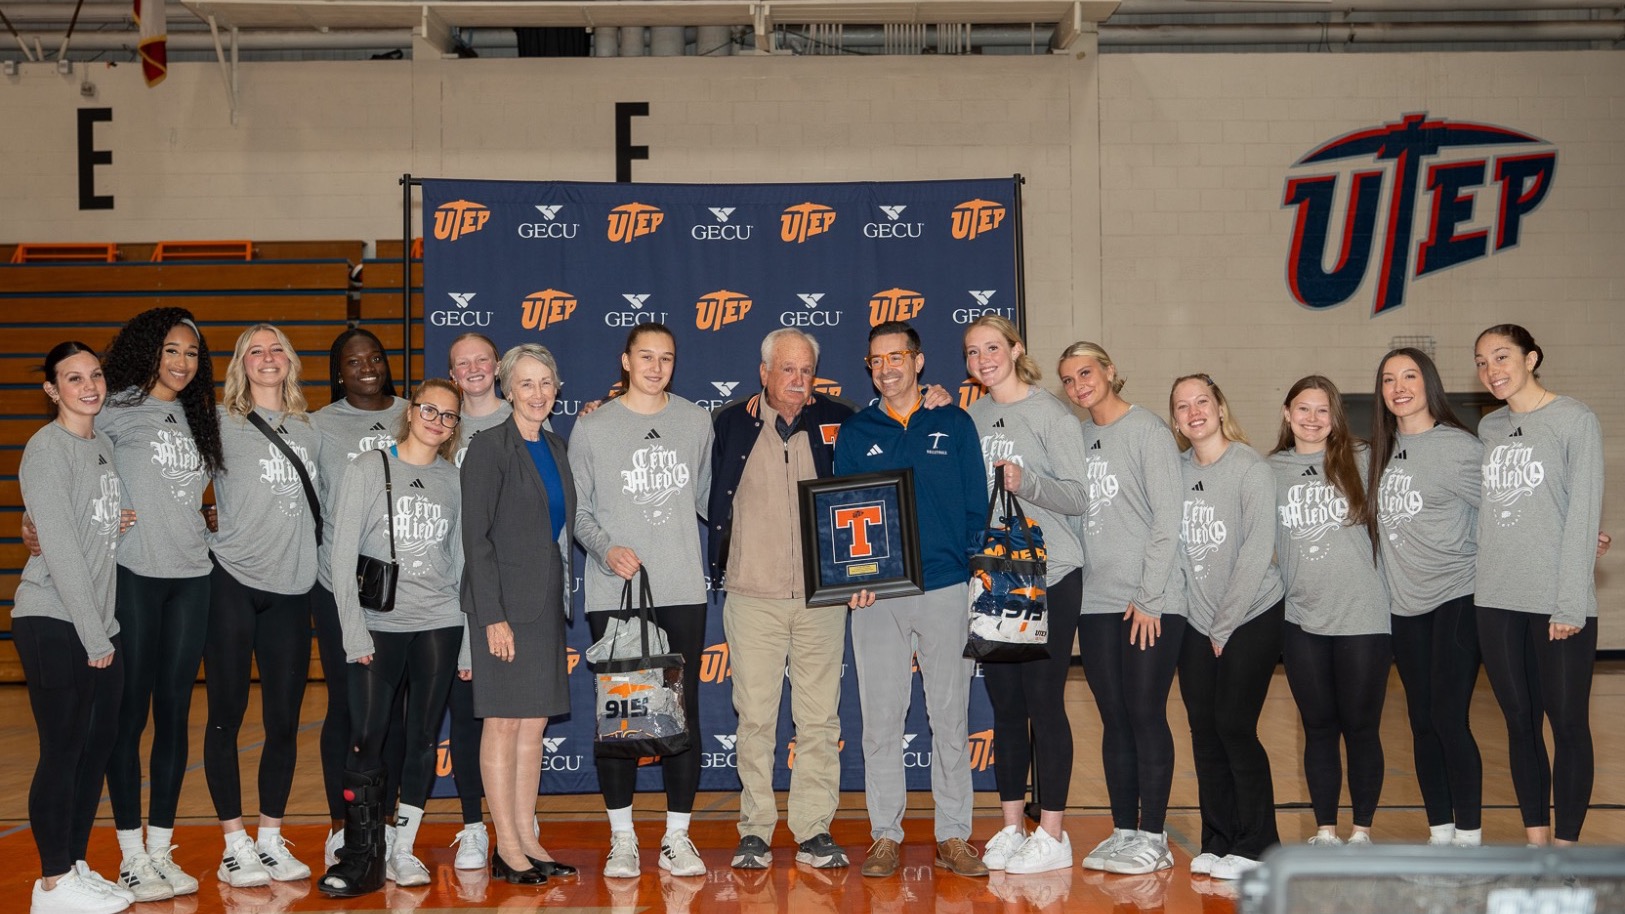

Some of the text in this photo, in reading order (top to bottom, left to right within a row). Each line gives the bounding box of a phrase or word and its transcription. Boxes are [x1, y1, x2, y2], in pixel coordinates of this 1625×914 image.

[77, 107, 115, 211] E
[615, 102, 650, 183] F
[433, 199, 491, 242] UTEP
[517, 222, 579, 239] GECU
[607, 202, 664, 244] UTEP
[691, 225, 752, 241] GECU
[780, 202, 836, 243] UTEP
[863, 222, 923, 239] GECU
[951, 198, 1006, 241] UTEP
[1280, 110, 1559, 319] UTEP
[430, 311, 492, 327] GECU
[521, 288, 578, 332] UTEP
[695, 289, 752, 332] UTEP
[780, 311, 842, 327] GECU
[868, 288, 925, 328] UTEP
[550, 400, 580, 416] CU
[835, 505, 882, 558] T
[605, 698, 648, 719] 915
[541, 755, 581, 771] ECU
[700, 752, 738, 769] GEC
[902, 751, 932, 768] CU
